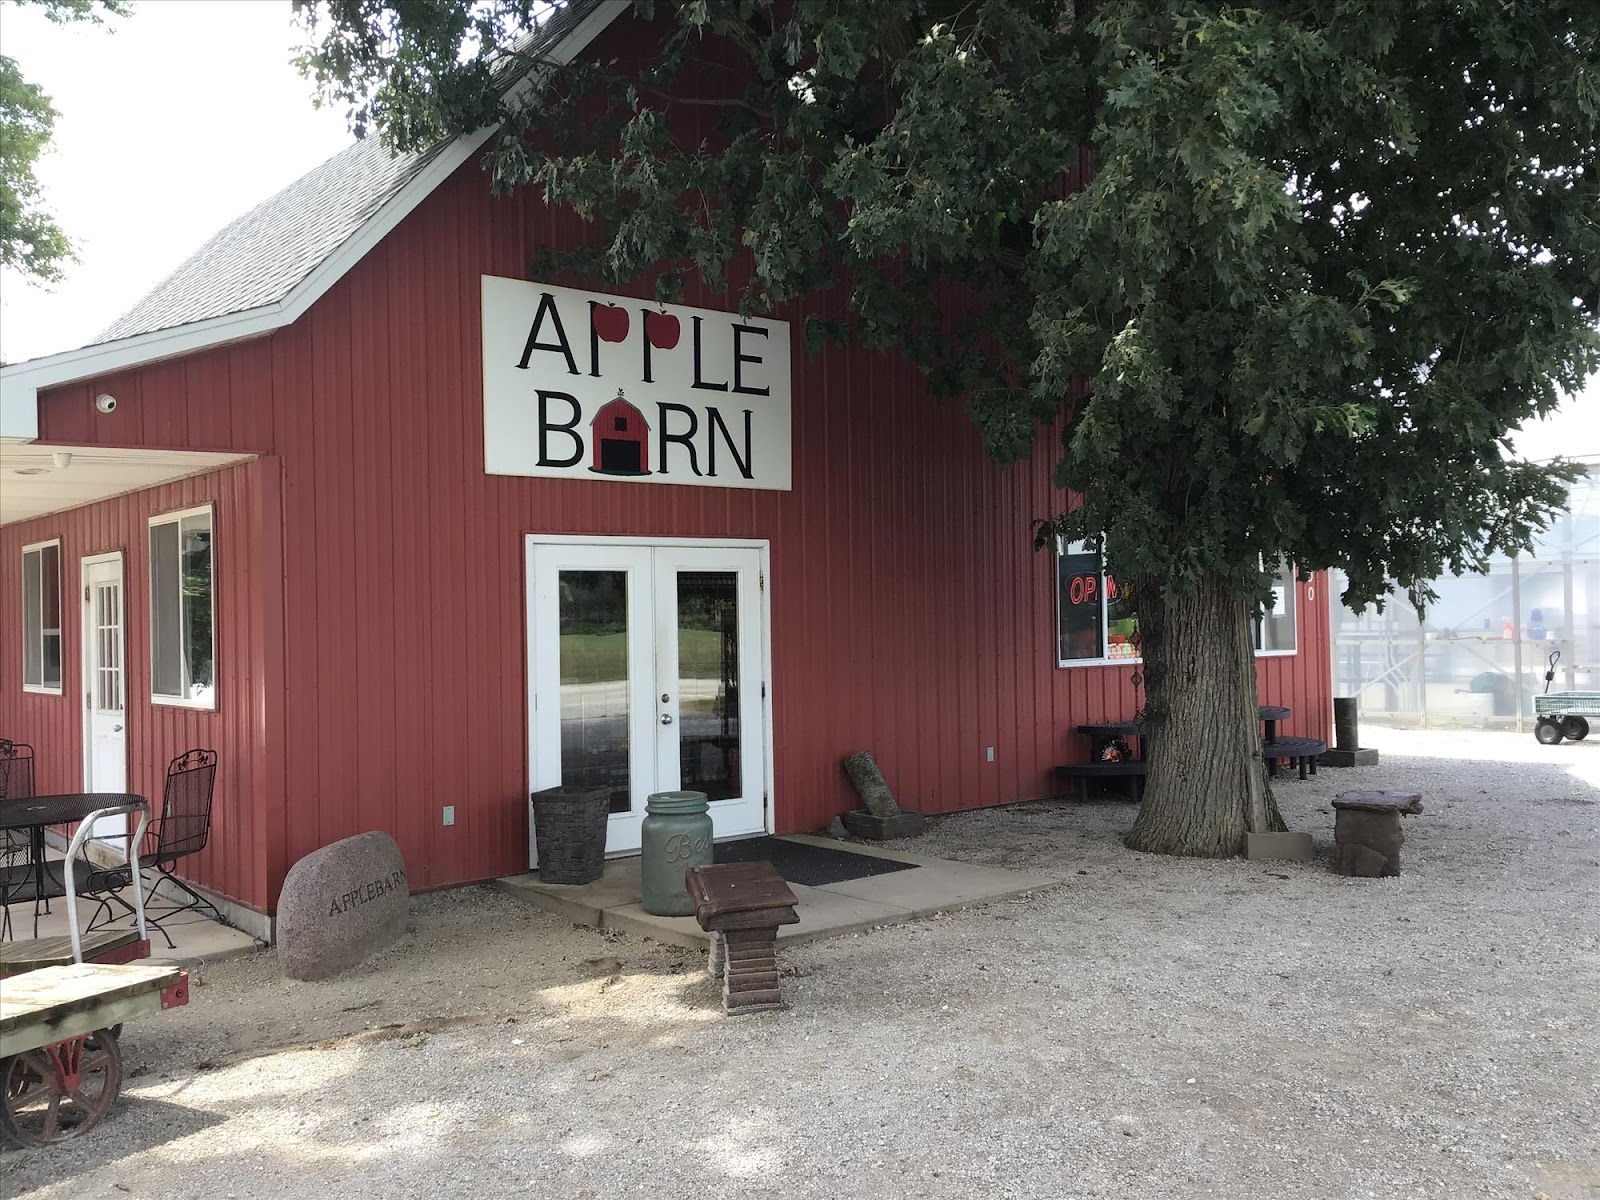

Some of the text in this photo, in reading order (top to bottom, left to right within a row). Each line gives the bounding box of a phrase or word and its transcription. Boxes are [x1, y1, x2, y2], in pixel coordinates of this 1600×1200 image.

[515, 292, 770, 396] APPLE
[534, 389, 754, 480] BARN
[1070, 574, 1118, 605] OPN
